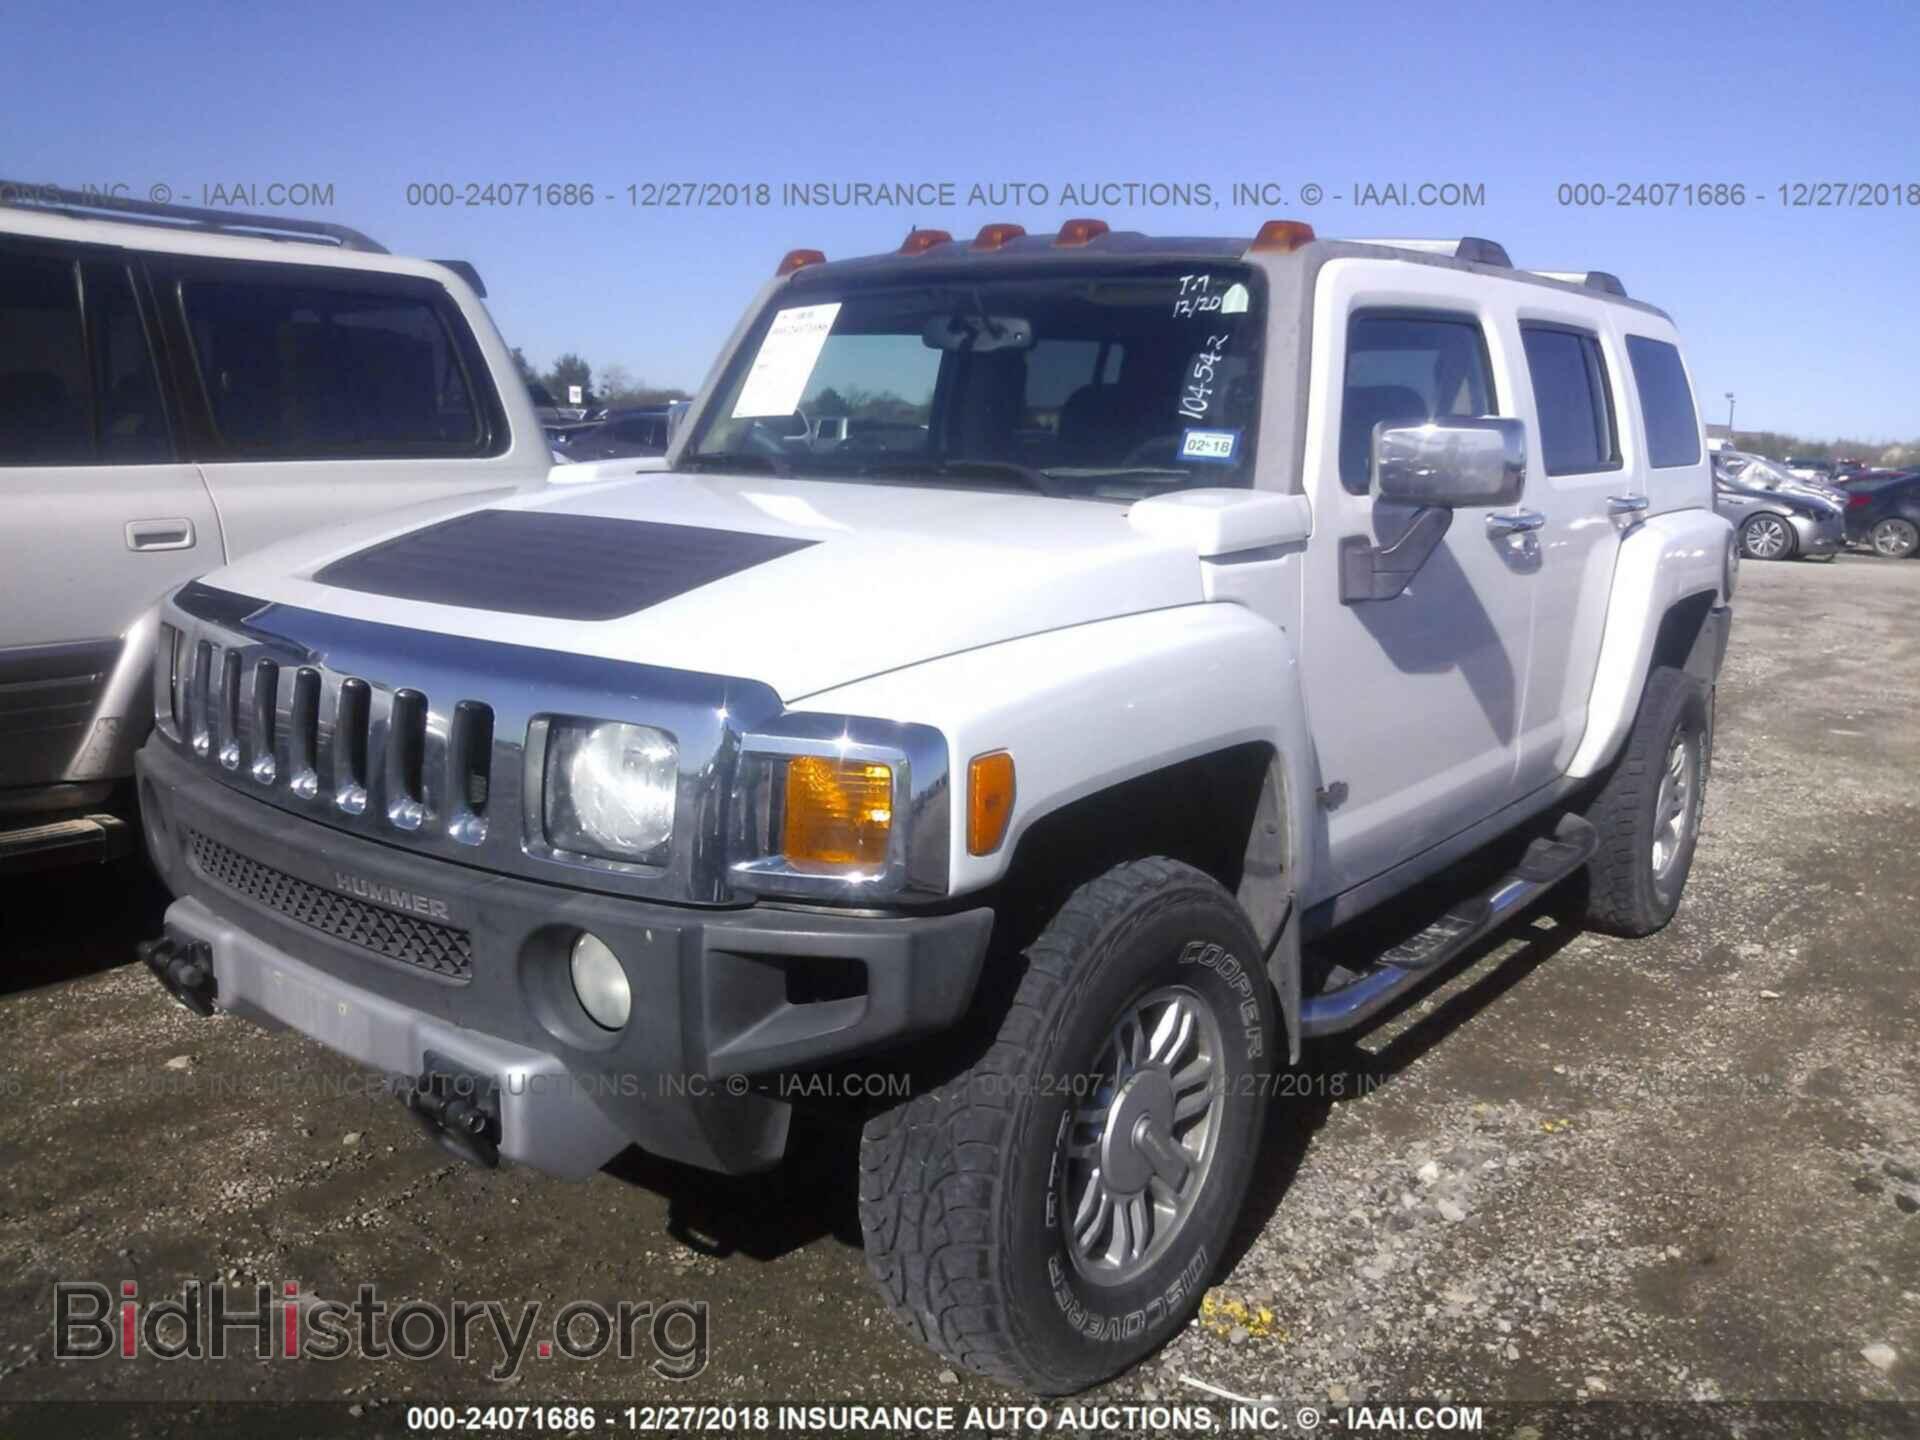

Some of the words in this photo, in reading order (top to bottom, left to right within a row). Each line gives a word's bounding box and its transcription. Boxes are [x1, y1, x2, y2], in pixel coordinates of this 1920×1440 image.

[1172, 296, 1221, 318] 12/20
[335, 872, 450, 920] HUMMER
[1177, 940, 1264, 1060] COOPER
[1047, 1244, 1209, 1342] DISCOVERER
